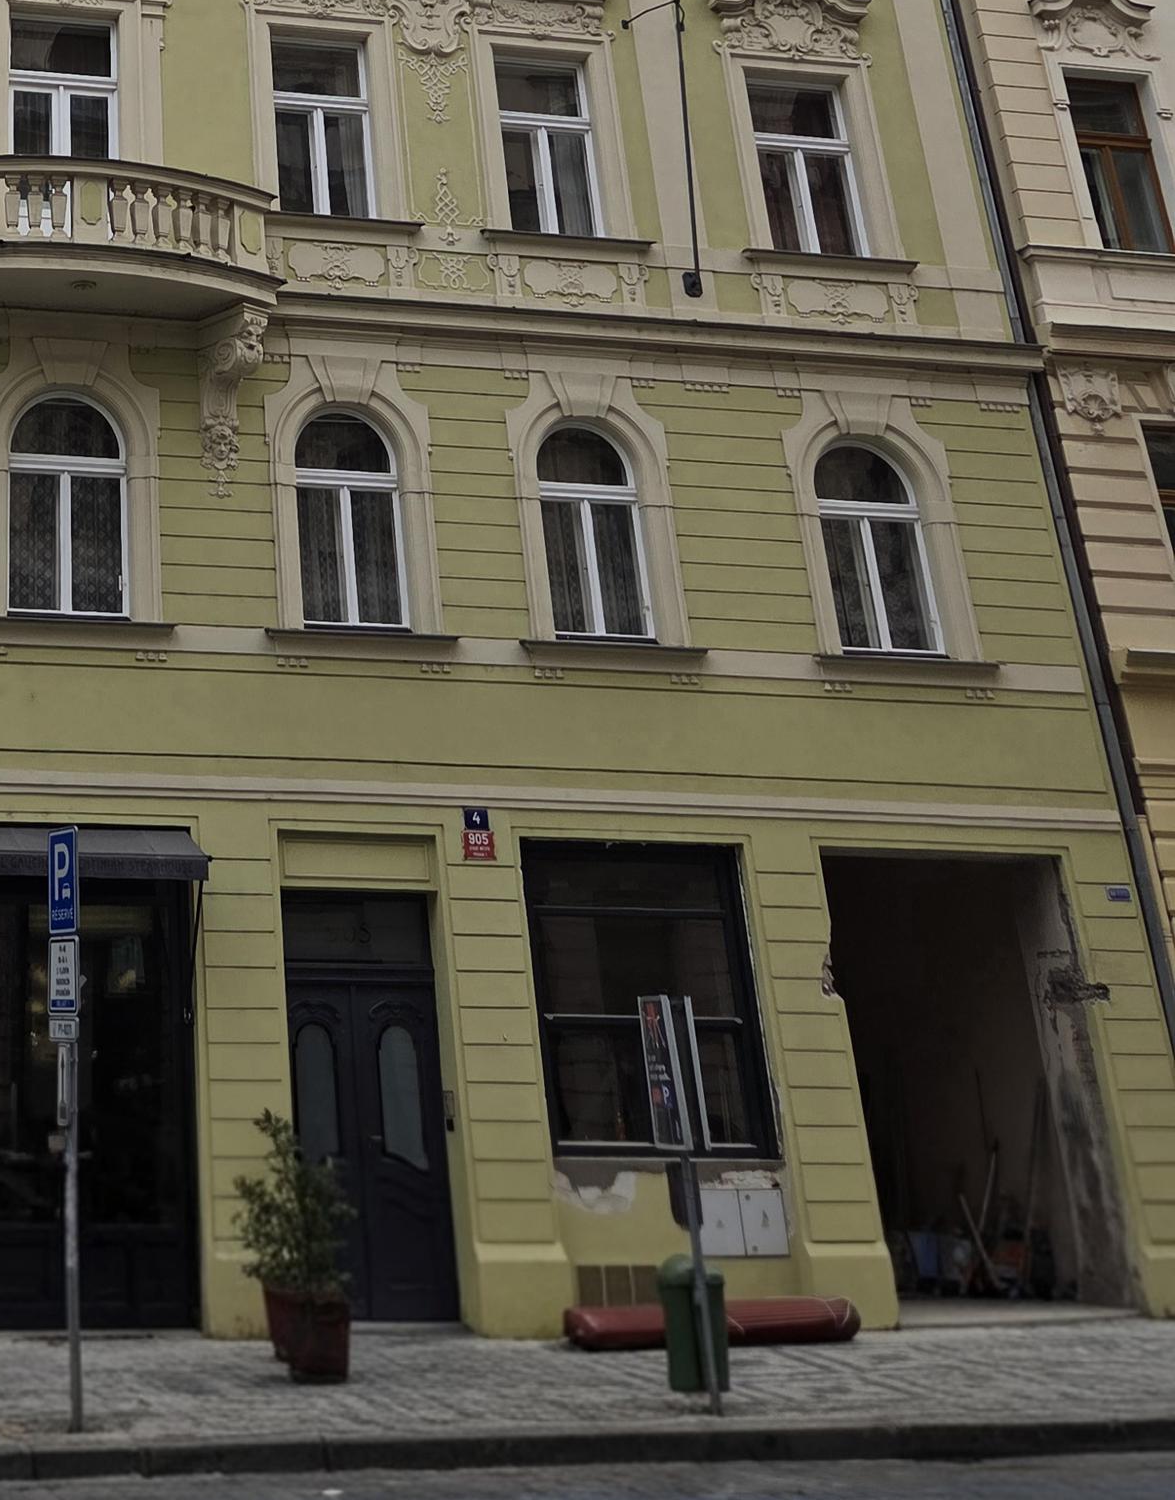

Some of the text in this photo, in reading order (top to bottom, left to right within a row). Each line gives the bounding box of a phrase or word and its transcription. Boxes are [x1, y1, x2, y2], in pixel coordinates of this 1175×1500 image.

[472, 811, 480, 825] 4
[468, 833, 489, 845] 905
[54, 842, 69, 901] P
